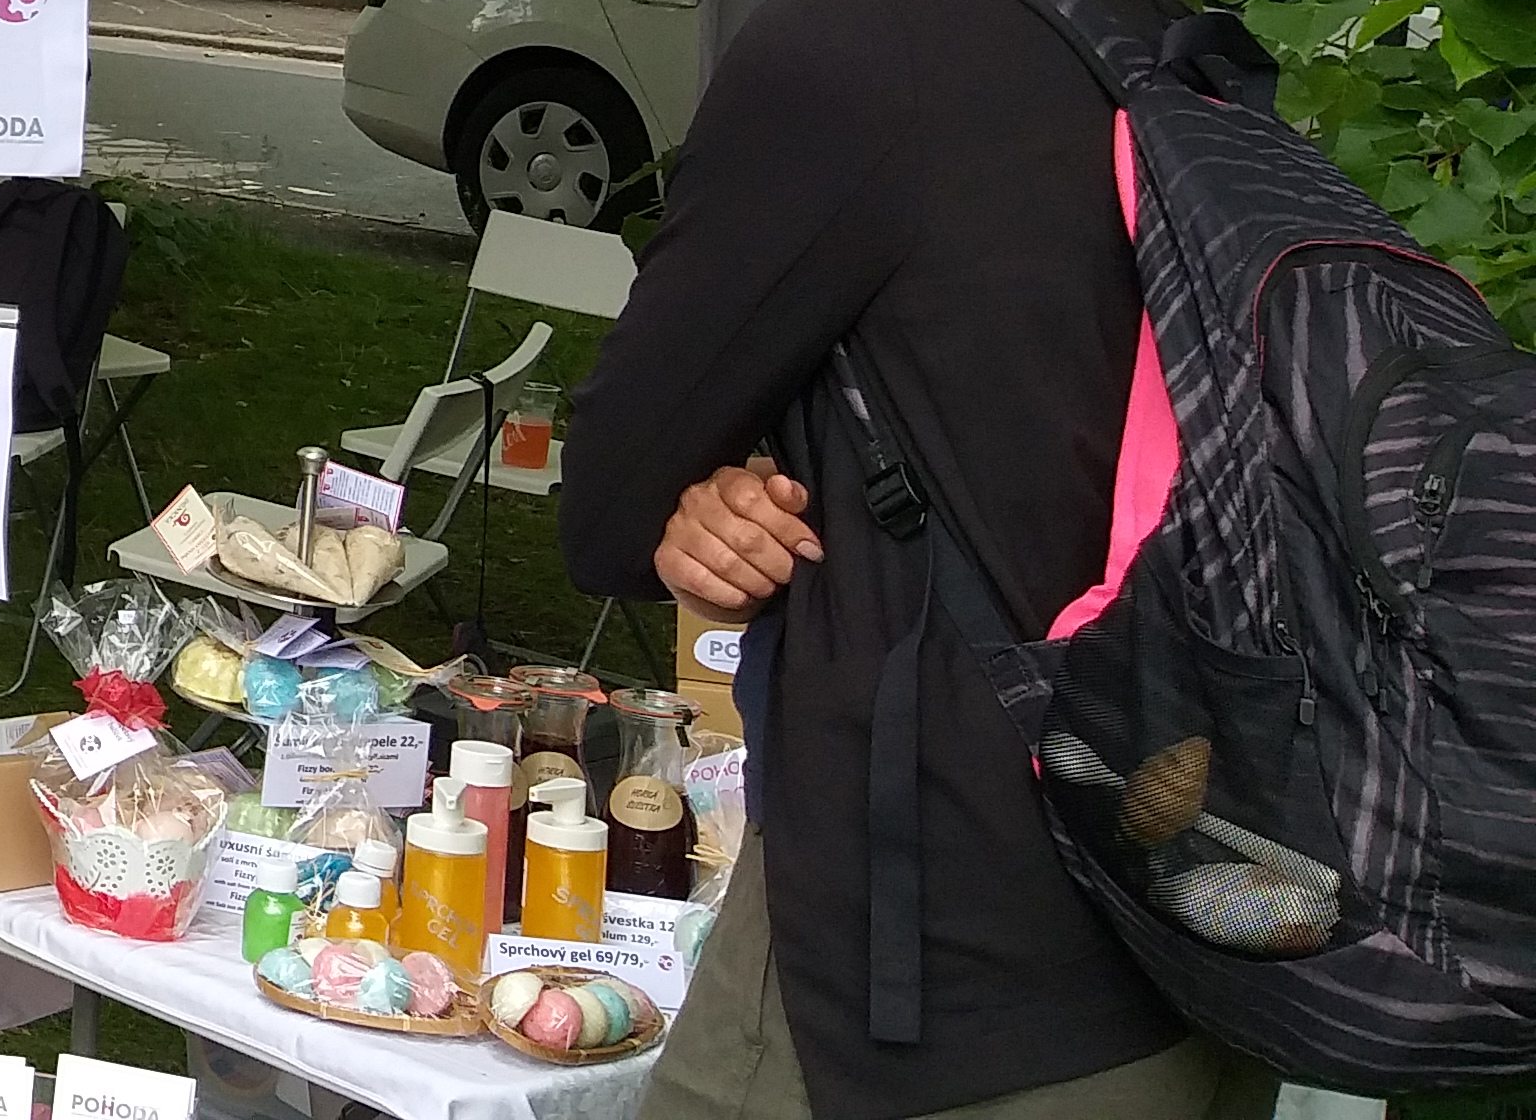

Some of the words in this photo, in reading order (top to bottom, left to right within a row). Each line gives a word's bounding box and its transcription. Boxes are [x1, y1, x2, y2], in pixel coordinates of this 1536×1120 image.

[399, 736, 424, 750] 22,-
[297, 764, 318, 774] Fizzy
[690, 760, 740, 784] POHO
[219, 840, 265, 856] uxusní
[234, 869, 256, 882] Fizzy
[659, 920, 675, 932] 12
[630, 933, 659, 947] 129,-
[499, 942, 567, 962] Sprchový
[570, 948, 592, 963] gel
[595, 950, 650, 969] 69/79,-
